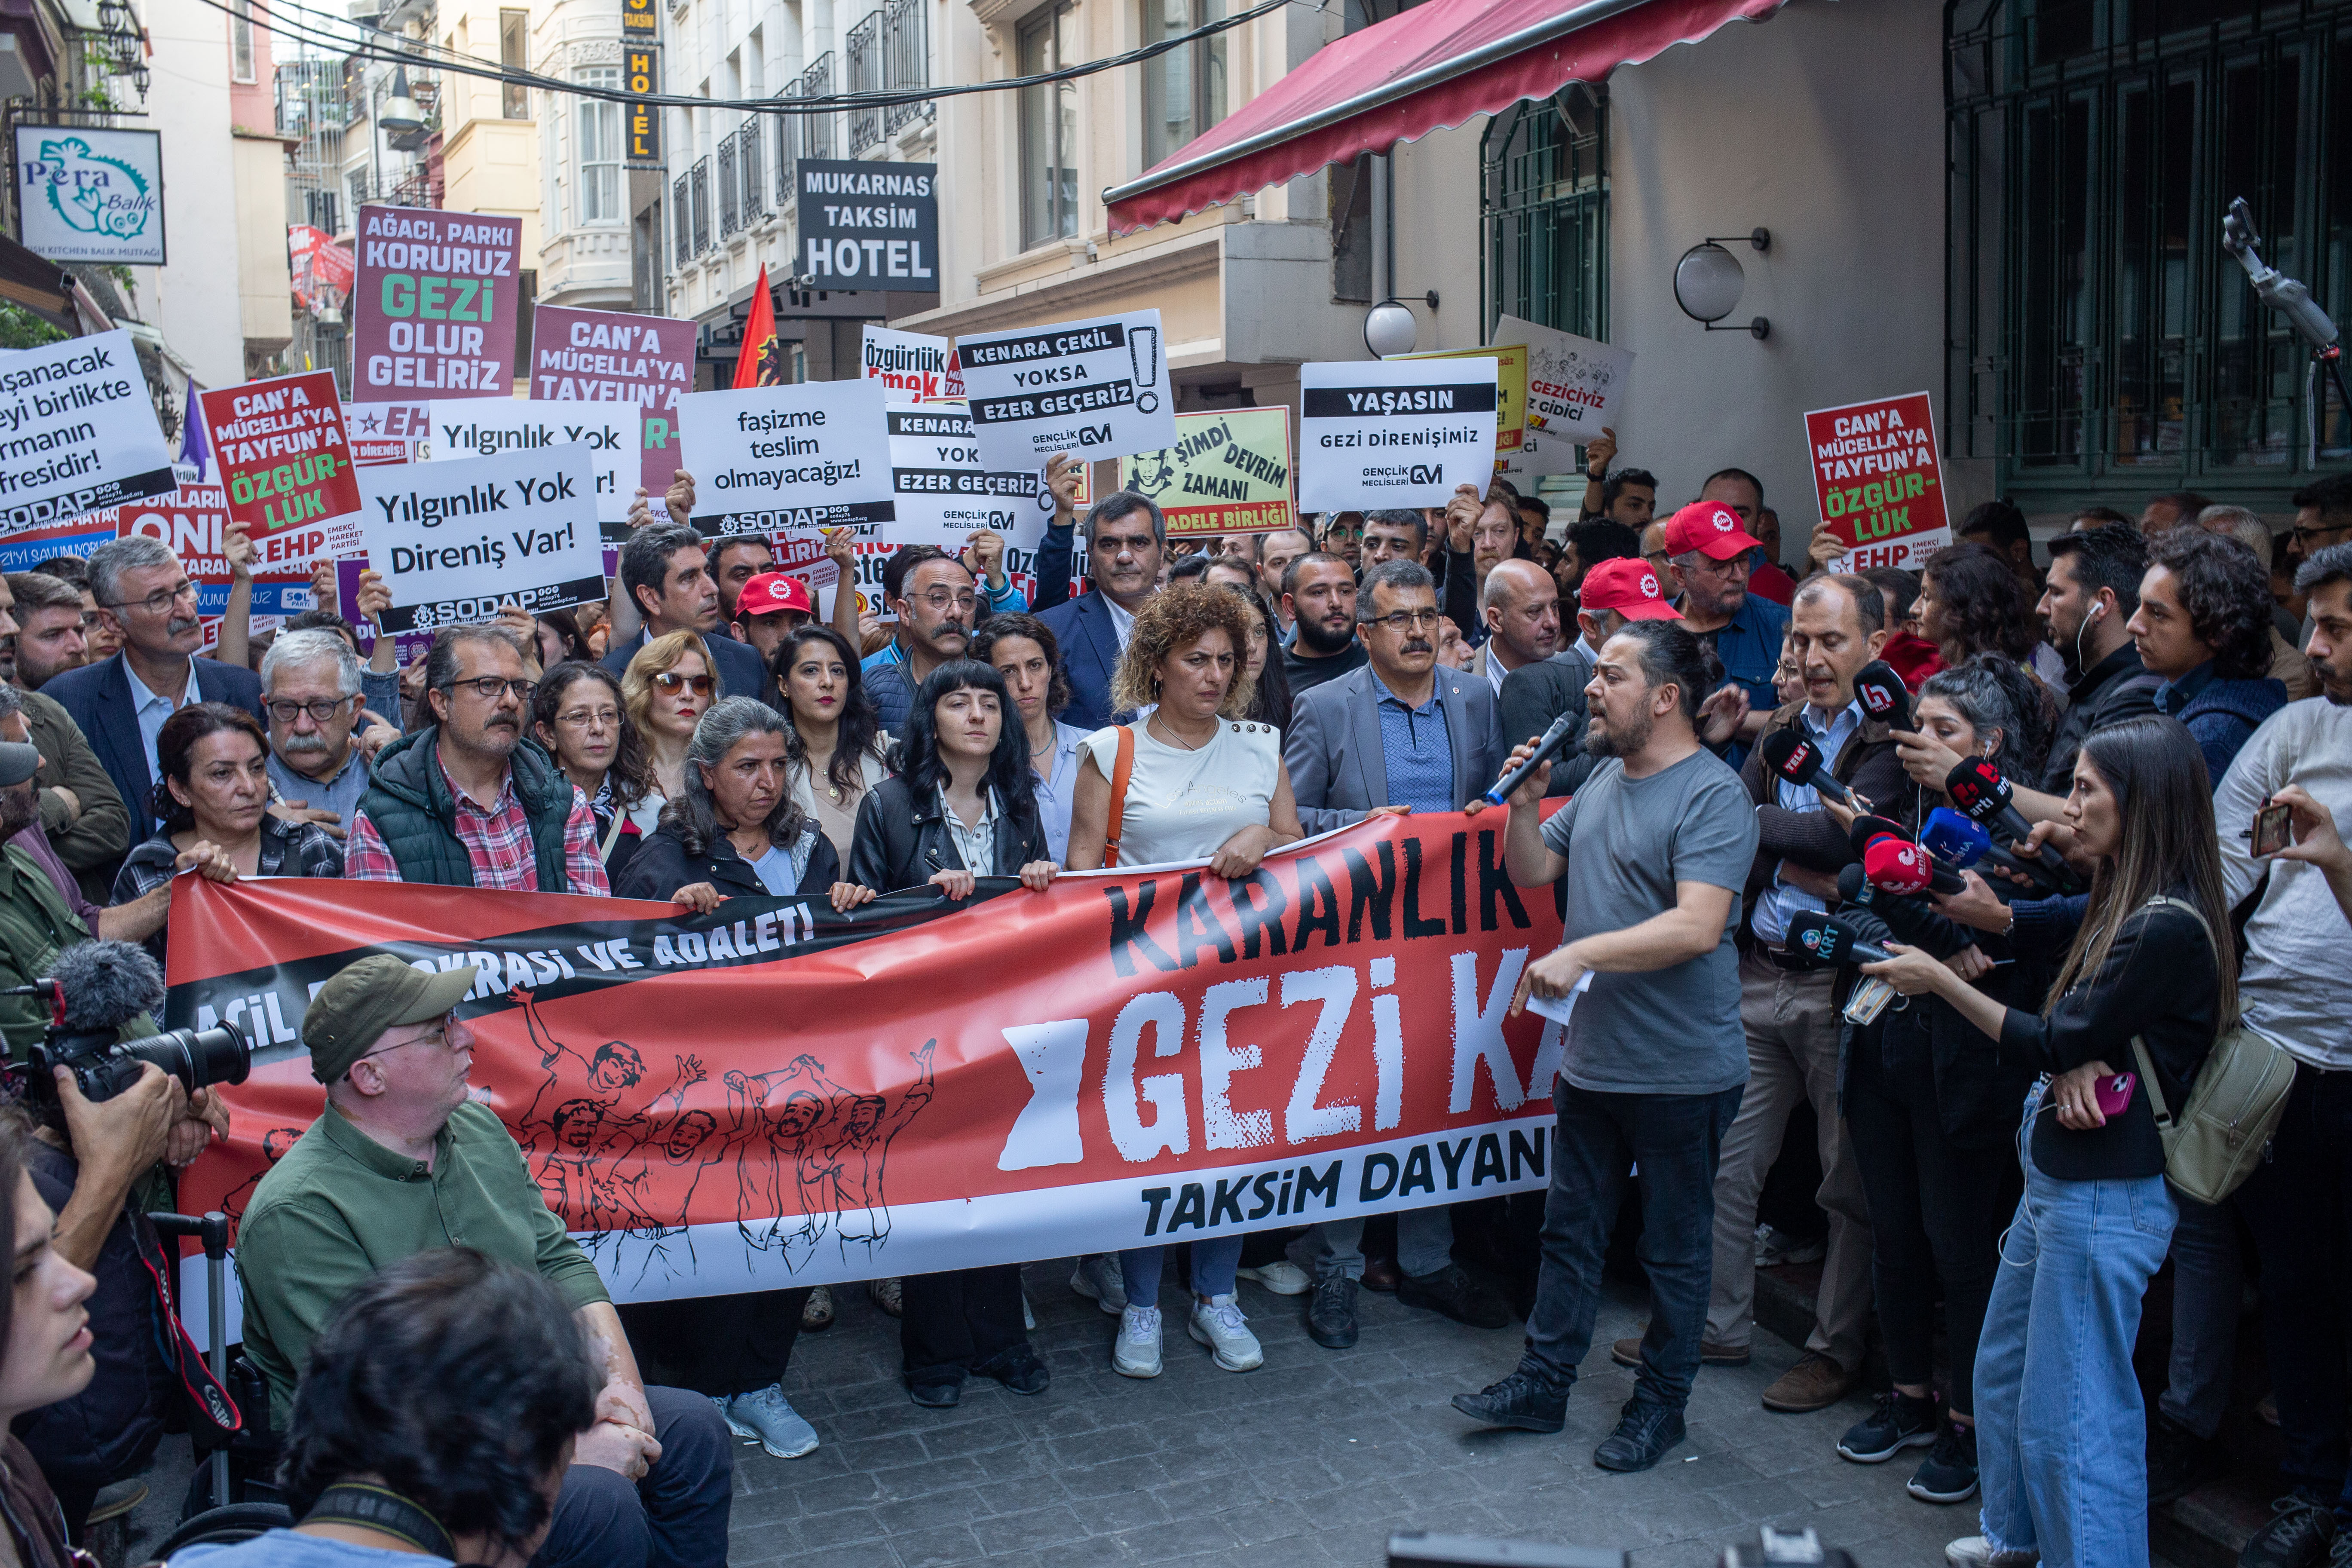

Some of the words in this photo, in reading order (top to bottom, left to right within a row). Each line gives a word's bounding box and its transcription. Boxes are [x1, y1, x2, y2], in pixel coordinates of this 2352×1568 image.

[631, 54, 649, 155] HOEL
[23, 161, 110, 187] Pera
[806, 172, 930, 196] MUKARNAS
[366, 212, 442, 244] AĞACI,
[447, 224, 513, 247] PARKI
[824, 203, 916, 228] TAKSİM
[48, 246, 87, 255] KITCHEN
[91, 247, 115, 255] BALIK
[366, 241, 512, 277] KORURUZ
[807, 238, 931, 278] HOTEL
[381, 273, 494, 323] GEZİ
[389, 322, 484, 356] OLUR
[570, 322, 661, 354] CAN'A
[972, 340, 1051, 363] KENARA
[1056, 328, 1112, 357] ÇEKİL
[540, 347, 686, 381] MÜCELLA'YA
[865, 339, 945, 373] Özgürlük
[368, 355, 501, 391] GELİRİZ
[1014, 364, 1088, 387] YOKSA
[33, 380, 132, 418] birlikte
[233, 387, 310, 418] CAN'A
[984, 397, 1034, 420] EZER
[1041, 384, 1131, 415] GEÇERİZ
[1347, 389, 1454, 416] YAŞASIN
[1531, 380, 1605, 408] GEZİCİYİZ
[215, 406, 337, 442] MÜCELLA'YA
[738, 410, 826, 435] faşizme
[1539, 400, 1583, 421] GİDİCİ
[1835, 409, 1904, 437] CAN'A
[442, 424, 555, 454] Yılgınlık
[900, 418, 976, 435] KENARA
[1032, 430, 1077, 444] GENÇLİK
[1174, 416, 1233, 467] ŞİMDİ
[1320, 430, 1362, 447] GEZİ
[1369, 426, 1478, 448] DİRENİŞİMİZ
[220, 426, 343, 465] TAYFUN'A
[750, 436, 819, 459] teslim
[1034, 441, 1079, 453] MECLİSLERİ
[1817, 428, 1928, 459] MÜCELLA'YA
[231, 453, 348, 505] ÖZGÜR-
[715, 459, 861, 490] olmayacağız!
[1224, 443, 1287, 488] DEVRİM
[1363, 465, 1408, 478] GENÇLİK
[1820, 447, 1932, 481] TAYFUN'A
[899, 474, 951, 490] EZER
[958, 474, 1035, 496] GEÇERİZ
[1182, 473, 1249, 501] ZAMANI
[1362, 477, 1408, 486] MECLİSLERİ
[1826, 472, 1936, 517] ÖZGÜR-
[264, 489, 326, 530] LÜK
[375, 483, 509, 527] Yılgınlık
[515, 472, 576, 506] Yok
[327, 522, 355, 534] EMEKÇİ
[739, 508, 827, 530] SODAP
[943, 509, 988, 521] GENÇLİK
[943, 521, 988, 530] MECLİSLERİ
[1166, 512, 1219, 530] ADELE
[1224, 503, 1286, 527] BİRLİĞİ
[1854, 506, 1912, 542] LÜK
[267, 530, 325, 564] EHP
[329, 530, 363, 542] HAREKET
[331, 539, 359, 551] PARTİSİ
[391, 535, 506, 574] Direniş
[512, 522, 575, 557] Var!
[1912, 538, 1939, 549] EMEKÇİ
[813, 564, 834, 575] EMEKÇİ
[1854, 545, 1909, 573] EHP
[813, 569, 839, 580] HAREKET
[814, 576, 835, 586] PARTİSİ
[1188, 781, 1246, 803] Angeles
[1105, 831, 1531, 977] KARANLIK
[577, 937, 644, 971] VE
[654, 902, 814, 967] ADALET!
[1817, 925, 1838, 959] KRT
[1103, 955, 1406, 1162] GEZİ
[1142, 1160, 1342, 1236] TAKSİM
